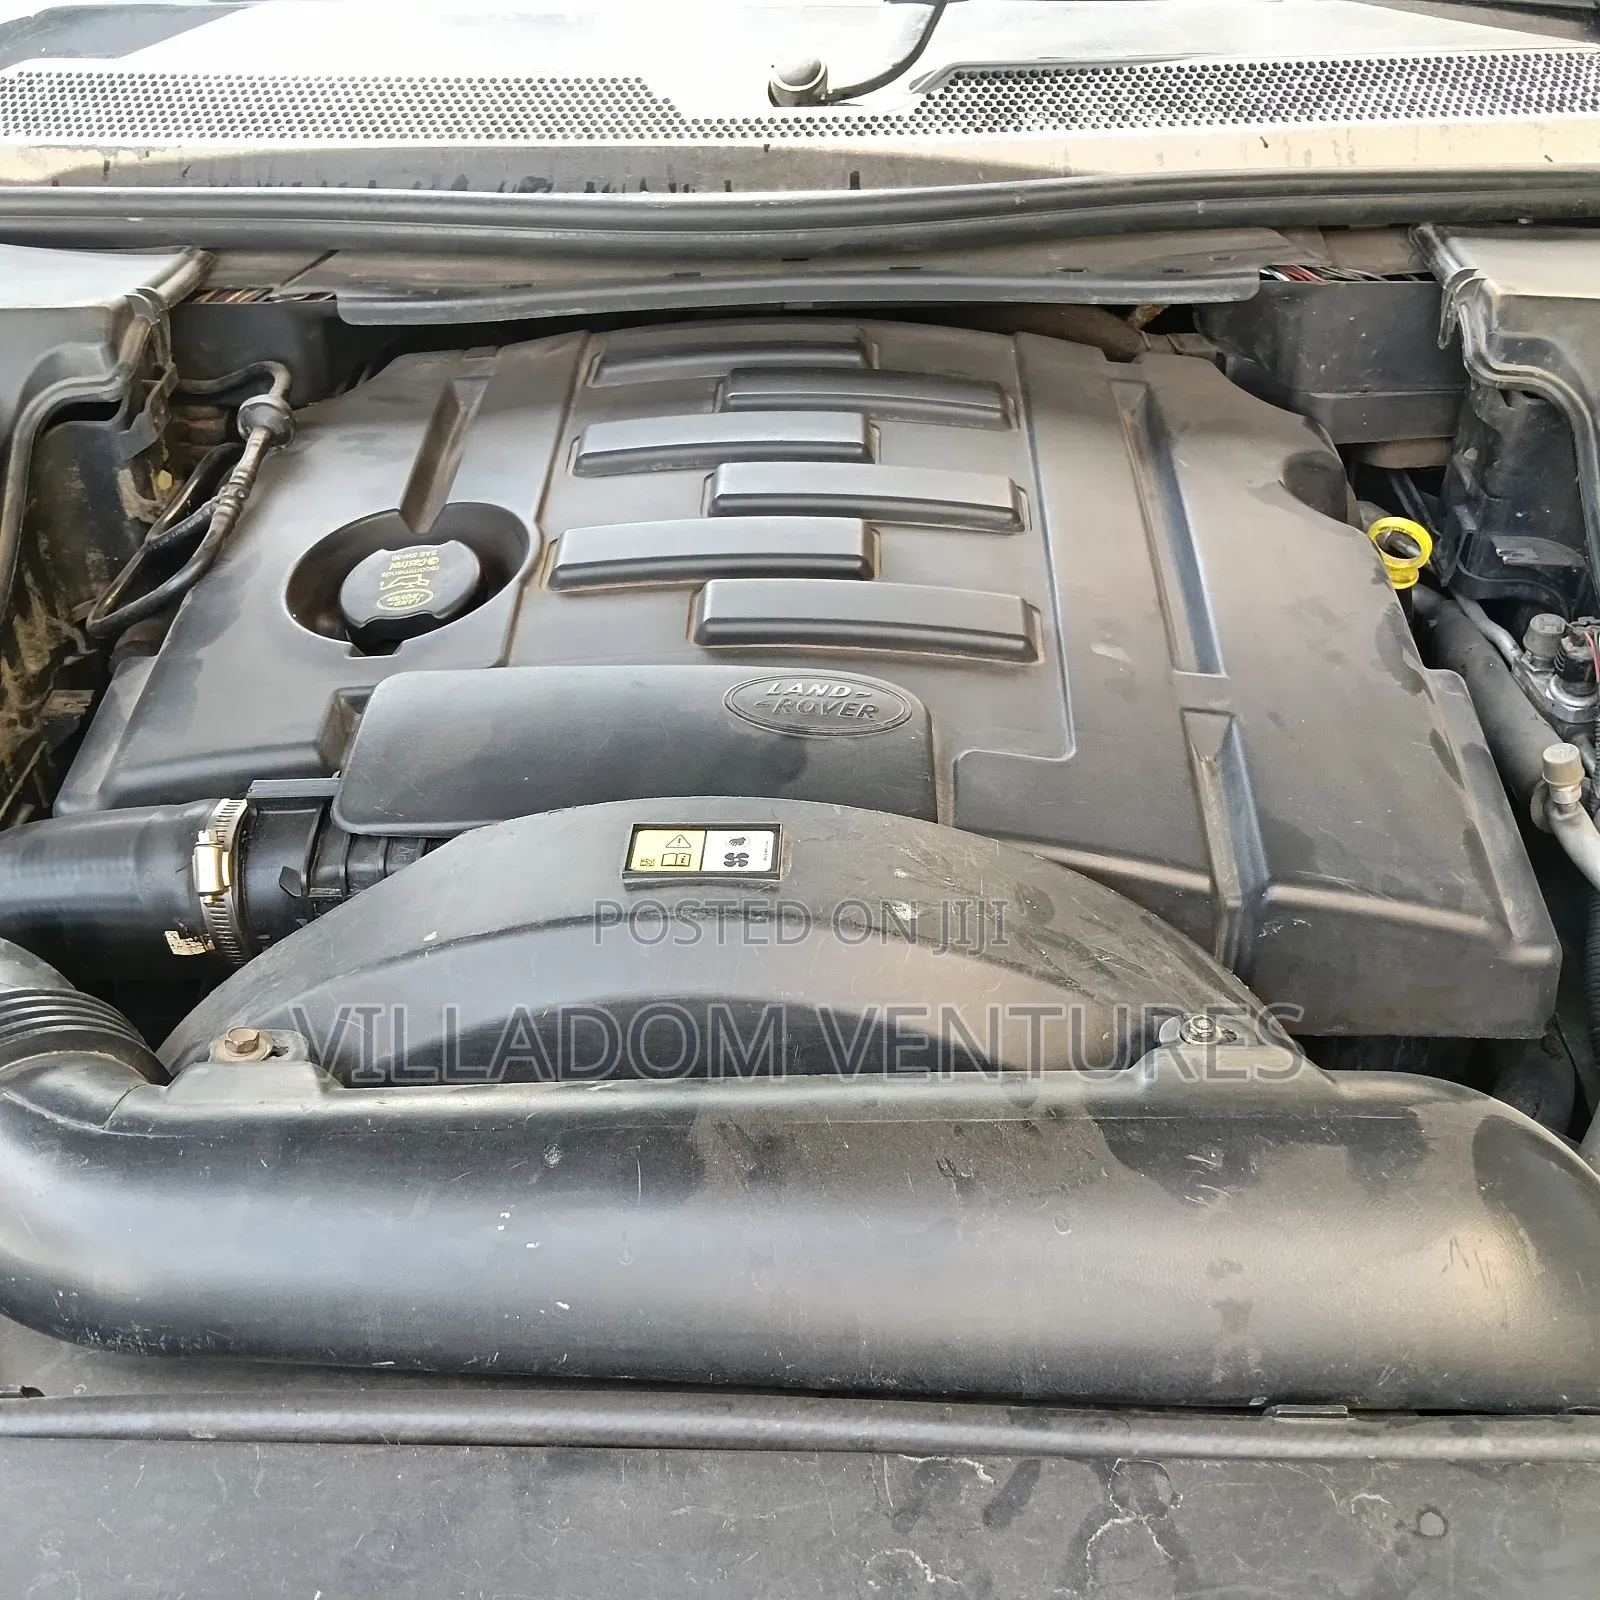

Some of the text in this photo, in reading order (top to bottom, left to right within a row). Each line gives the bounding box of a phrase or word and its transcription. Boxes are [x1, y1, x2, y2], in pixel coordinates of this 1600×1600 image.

[420, 549, 438, 557] SAE
[388, 558, 427, 570] Castrol
[381, 566, 440, 578] recommends
[766, 682, 852, 698] LAND
[771, 697, 880, 721] ROVER
